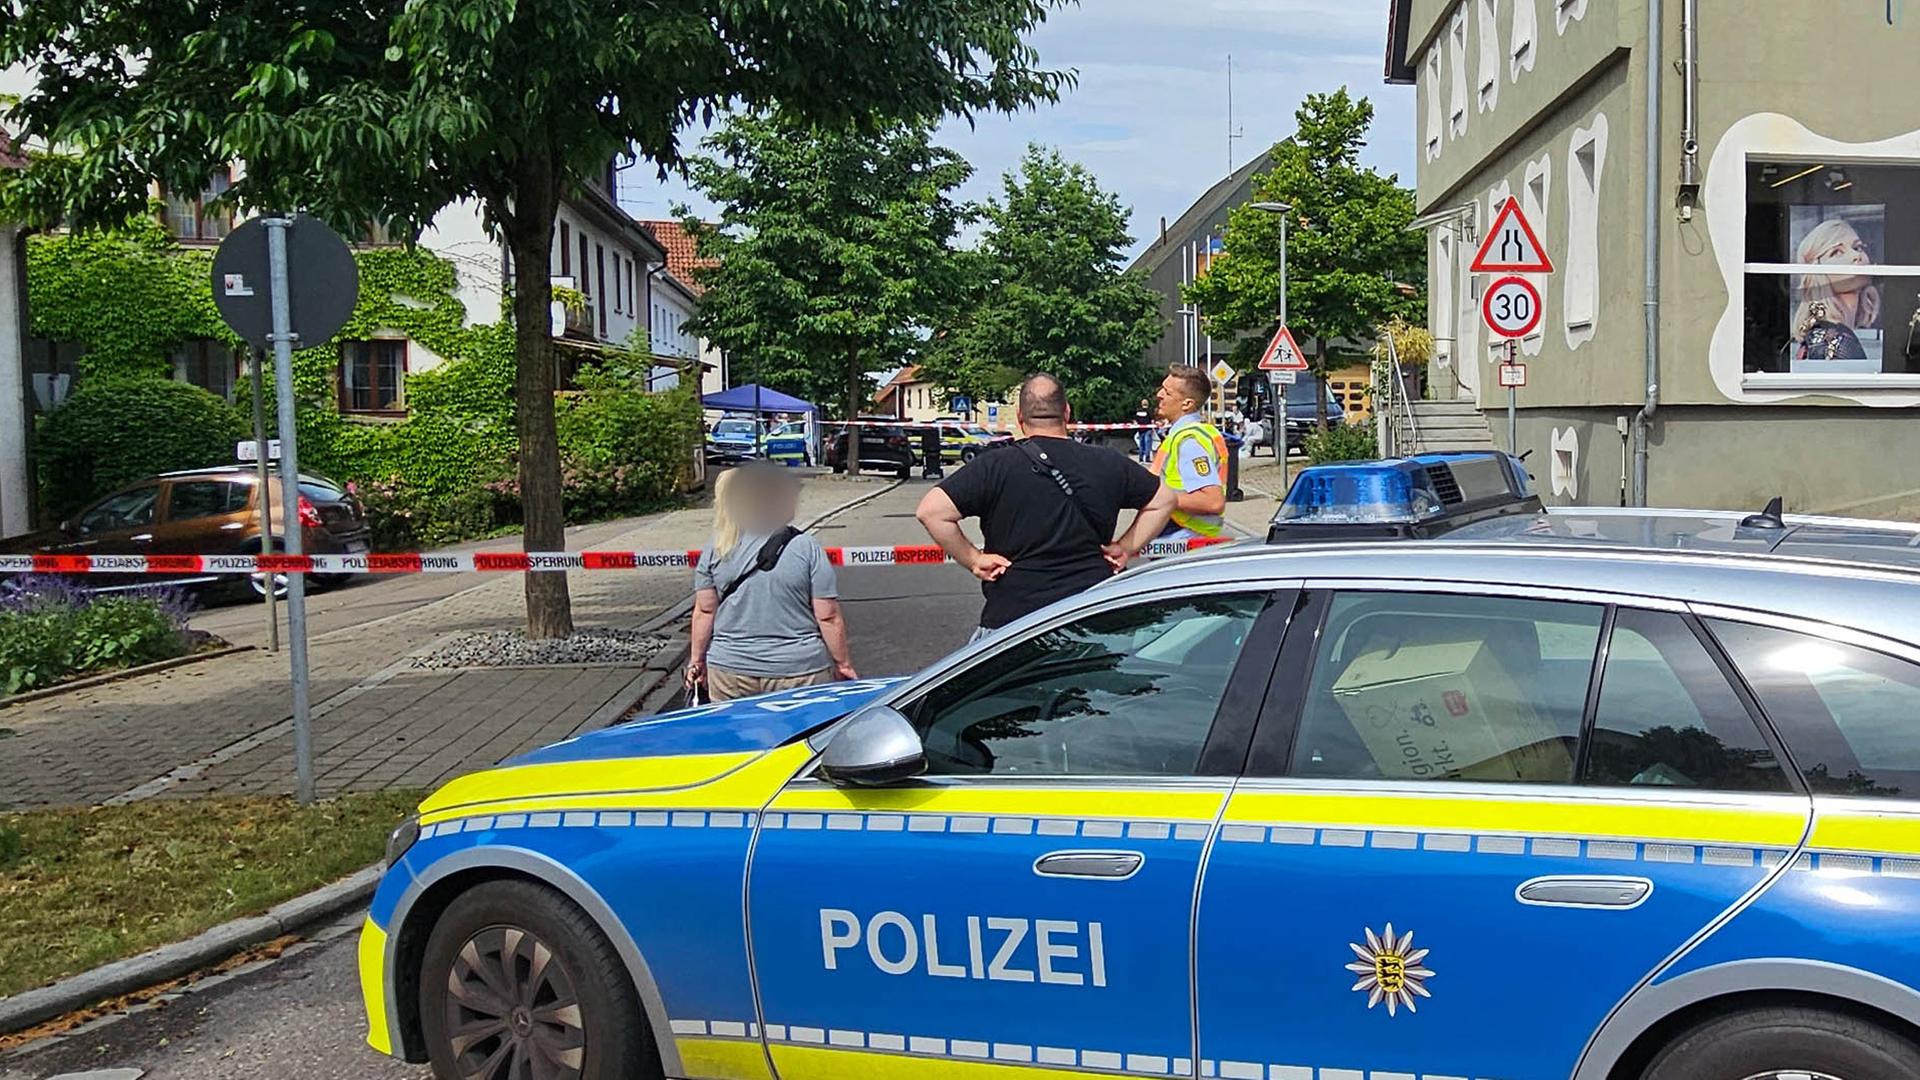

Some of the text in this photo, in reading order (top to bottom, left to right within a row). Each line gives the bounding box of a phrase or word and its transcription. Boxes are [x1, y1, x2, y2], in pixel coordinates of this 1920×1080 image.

[1495, 293, 1529, 321] 30
[209, 556, 328, 569] POLIZEIABSPERRUNG
[341, 556, 459, 569] POLIZEIABSPERRUNG
[472, 553, 586, 570] POLIZEIABSPERRUNG
[819, 908, 1106, 987] POLIZEI
